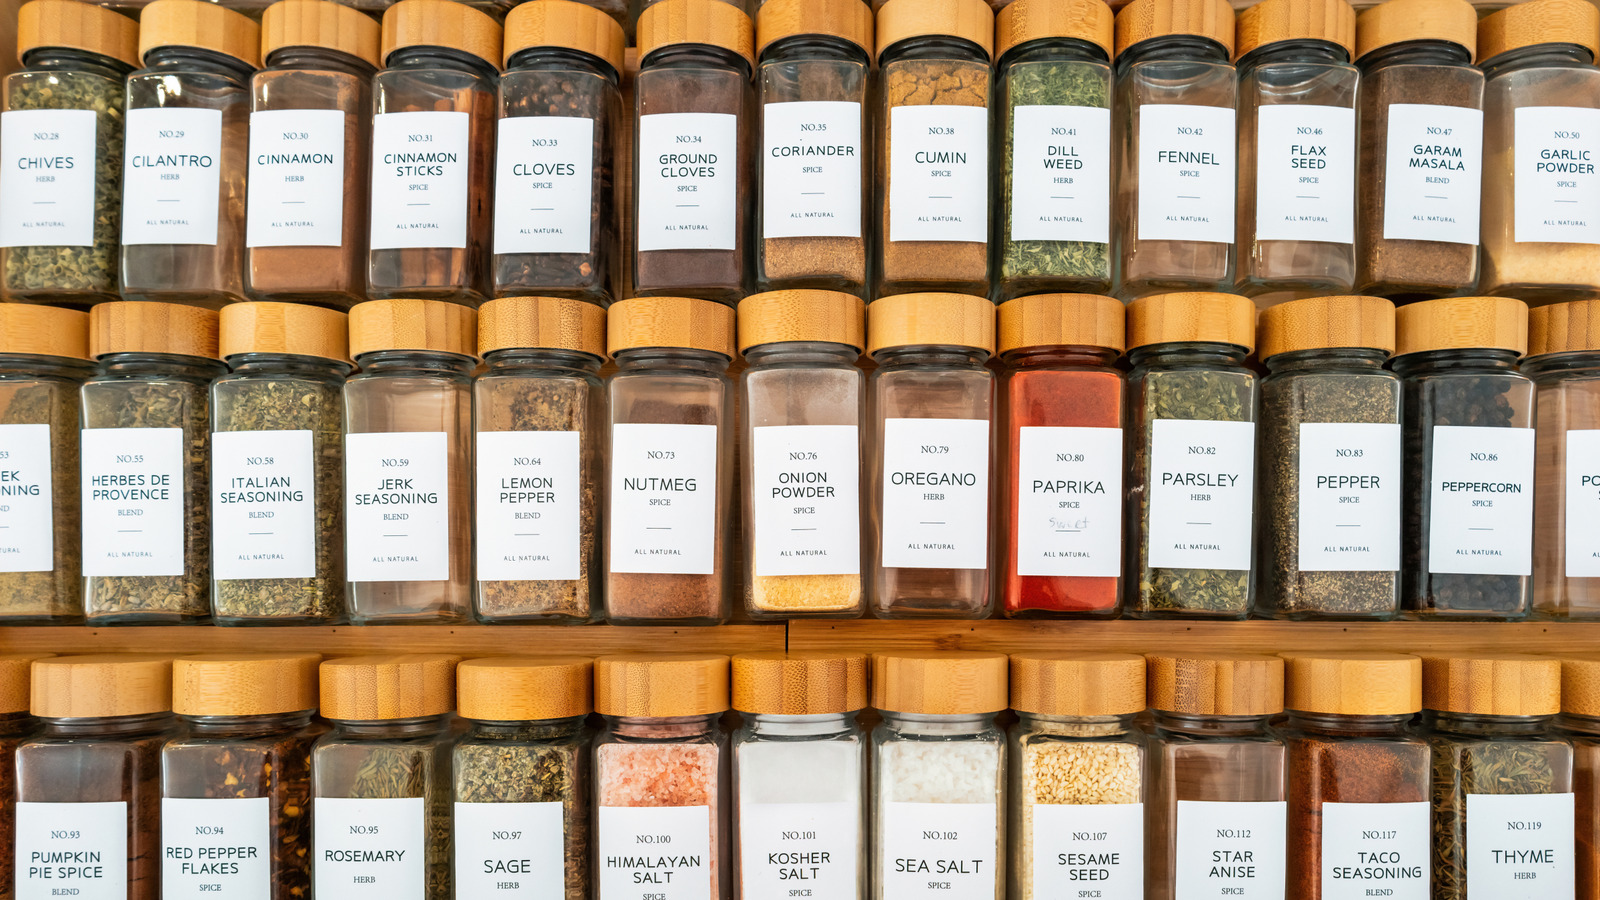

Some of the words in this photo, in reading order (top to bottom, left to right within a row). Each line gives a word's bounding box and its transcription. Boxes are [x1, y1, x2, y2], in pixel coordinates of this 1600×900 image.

[800, 122, 827, 132] NO.35
[928, 126, 955, 136] NO.38
[1050, 127, 1077, 137] NO.41
[1177, 126, 1204, 137] NO.42
[1296, 126, 1324, 136] NO.46
[1426, 126, 1453, 136] NO.47
[33, 132, 60, 141] NO.28
[158, 129, 185, 139] NO.29
[282, 131, 309, 141] NO.30
[407, 133, 433, 143] NO.31
[675, 134, 702, 144] NO.34
[1553, 130, 1581, 140] NO.50
[531, 138, 558, 148] NO.33
[771, 145, 855, 158] CORIANDER
[1047, 145, 1080, 157] DILL
[1290, 144, 1327, 157] FLAX
[1412, 143, 1463, 159] GARAM
[1540, 148, 1591, 162] GARLIC
[131, 154, 213, 169] CILANTRO
[257, 152, 334, 166] CINNAMON
[383, 151, 457, 165] CINNAMON
[658, 153, 718, 166] GROUND
[914, 151, 967, 165] CUMIN
[1158, 150, 1221, 166] FENNEL
[17, 156, 75, 171] CHIVES
[1042, 158, 1084, 171] WEED
[1290, 157, 1327, 170] SEED
[1408, 157, 1466, 172] MASALA
[1536, 161, 1595, 175] POWDER
[396, 165, 444, 178] STICKS
[512, 162, 576, 177] CLOVES
[660, 166, 716, 179] CLOVES
[802, 165, 823, 174] SPICE
[930, 169, 952, 178] SPICE
[1179, 169, 1201, 178] SPICE
[35, 175, 56, 183] HERB
[160, 173, 181, 181] HERB
[284, 175, 305, 183] HERB
[1053, 176, 1074, 185] HERB
[1298, 176, 1320, 184] SPICE
[1425, 175, 1451, 185] BLEND
[408, 183, 429, 191] SPICE
[532, 181, 553, 190] SPICE
[676, 184, 698, 193] SPICE
[1556, 180, 1577, 189] SPICE
[917, 215, 930, 223] ALL
[931, 215, 962, 223] NATURAL
[1053, 215, 1084, 223] NATURAL
[395, 222, 407, 230] ALL
[409, 222, 439, 230] NATURAL
[533, 227, 563, 235] NATURAL
[920, 444, 950, 455] NO.79
[1187, 445, 1217, 456] NO.82
[1335, 448, 1364, 458] NO.83
[116, 454, 144, 464] NO.55
[647, 450, 676, 460] NO.73
[789, 451, 818, 461] NO.76
[1055, 453, 1085, 463] NO.80
[1469, 452, 1499, 462] NO.86
[246, 456, 275, 466] NO.58
[381, 458, 410, 468] NO.59
[513, 456, 542, 466] NO.64
[91, 474, 146, 487] HERBES
[150, 473, 171, 486] DE
[231, 475, 291, 489] ITALIAN
[501, 476, 553, 490] LEMON
[778, 471, 828, 485] ONION
[890, 471, 977, 487] OREGANO
[1162, 471, 1239, 488] PARSLEY
[1316, 475, 1381, 489] PEPPER
[376, 478, 414, 491] JERK
[623, 477, 697, 492] NUTMEG
[1032, 479, 1106, 495] PAPRIKA
[1441, 481, 1522, 494] PEPPERCORN
[92, 488, 170, 502] PROVENCE
[219, 490, 304, 504] SEASONING
[771, 485, 836, 499] POWDER
[923, 492, 945, 501] HERB
[354, 492, 438, 506] SEASONING
[499, 491, 556, 504] PEPPER
[648, 498, 672, 507] SPICE
[1190, 493, 1212, 502] HERB
[1338, 495, 1361, 504] SPICE
[1058, 500, 1081, 509] SPICE
[1471, 499, 1494, 508] SPICE
[117, 508, 144, 517] BLEND
[248, 510, 275, 519] BLEND
[514, 511, 542, 520] BLEND
[792, 506, 816, 515] SPICE
[383, 512, 410, 521] BLEND
[634, 548, 647, 556] ALL
[649, 548, 682, 556] NATURAL
[923, 543, 956, 551] NATURAL
[1189, 543, 1221, 551] NATURAL
[1323, 545, 1337, 553] ALL
[1339, 545, 1370, 553] NATURAL
[1455, 548, 1469, 556] ALL
[1471, 549, 1503, 557] NATURAL
[195, 825, 225, 836] NO.94
[349, 825, 379, 835] NO.95
[1506, 820, 1543, 831] NO.119
[50, 829, 81, 840] NO.93
[492, 830, 523, 841] NO.97
[781, 830, 817, 841] NO.101
[922, 830, 958, 841] NO.102
[1072, 831, 1108, 842] NO.107
[1216, 828, 1252, 839] NO.112
[1361, 830, 1397, 840] NO.117
[635, 834, 672, 845] NO.100
[31, 850, 101, 864] PUMPKIN
[165, 846, 194, 860] RED
[198, 846, 258, 860] PEPPER
[324, 849, 406, 863] ROSEMARY
[768, 851, 831, 865] KOSHER
[1212, 849, 1254, 864] STAR
[1356, 851, 1401, 865] TACO
[1490, 848, 1555, 865] THYME
[606, 854, 701, 869] HIMALAYAN
[1057, 852, 1120, 866] SESAME
[181, 861, 239, 875] FLAKES
[483, 858, 532, 874] SAGE
[894, 857, 931, 874] SEA
[935, 859, 984, 874] SALT
[28, 866, 53, 880] PIE
[57, 865, 104, 880] SPICE
[778, 866, 820, 881] SALT
[1069, 868, 1110, 882] SEED
[1208, 865, 1256, 879] ANISE
[1332, 865, 1423, 880] SEASONING
[1513, 871, 1537, 880] HERB
[353, 875, 376, 884] HERB
[632, 871, 674, 885] SALT
[198, 883, 223, 892] SPICE
[496, 881, 520, 890] HERB
[927, 881, 952, 890] SPICE
[51, 887, 80, 896] BLEND
[642, 892, 667, 900] SPICE
[788, 888, 813, 898] SPICE
[1077, 889, 1102, 899] SPICE
[1220, 886, 1245, 896] SPICE
[1365, 888, 1394, 897] BLEND
